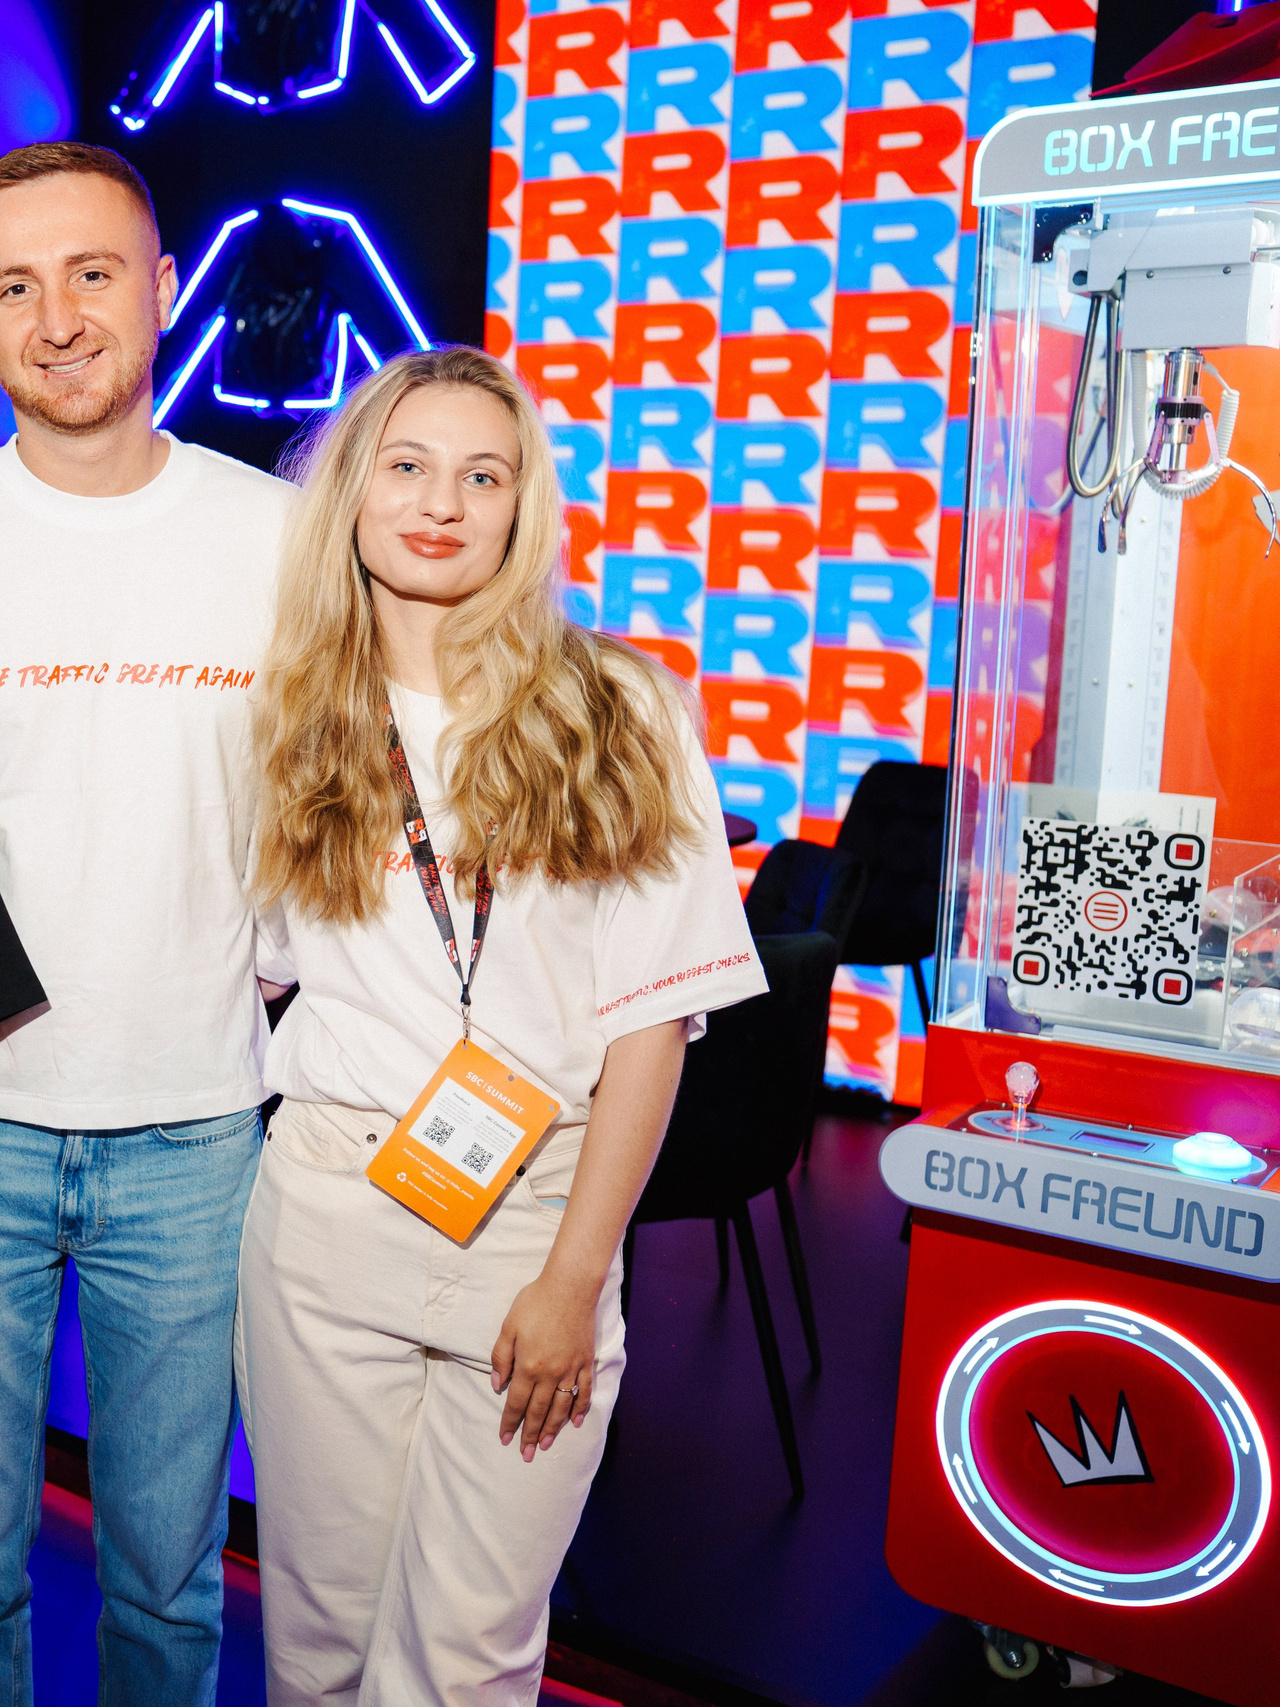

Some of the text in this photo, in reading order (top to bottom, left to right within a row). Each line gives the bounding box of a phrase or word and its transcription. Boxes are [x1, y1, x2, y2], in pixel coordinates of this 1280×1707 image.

[527, 7, 626, 97] R
[625, 43, 732, 132] R
[846, 11, 971, 108] R
[523, 93, 622, 179] R
[731, 66, 844, 159] R
[841, 105, 964, 199] R
[1044, 119, 1155, 176] BOX
[621, 131, 726, 217] R
[726, 155, 840, 247] R
[520, 176, 619, 260] R
[617, 218, 722, 301] R
[836, 199, 957, 290] R
[517, 260, 612, 341] R
[721, 246, 832, 333] R
[614, 302, 716, 386] R
[716, 333, 829, 419] R
[831, 291, 951, 380] R
[610, 388, 712, 467] R
[712, 423, 821, 503] R
[826, 383, 946, 467] R
[603, 471, 708, 550] R
[707, 506, 816, 591] R
[818, 471, 938, 556] R
[602, 555, 702, 634] R
[702, 595, 809, 676] R
[815, 562, 931, 648] R
[17, 663, 109, 689] TRAFFIC
[116, 663, 194, 688] GREAT
[195, 666, 255, 691] AGAIN
[807, 647, 925, 735] R
[701, 677, 805, 763] R
[653, 975, 676, 992] YOUR
[677, 961, 715, 983] BIGGEST
[466, 1071, 484, 1087] SBC
[486, 1085, 524, 1115] SUMMIT
[924, 1149, 1265, 1257] BOX FREUND
